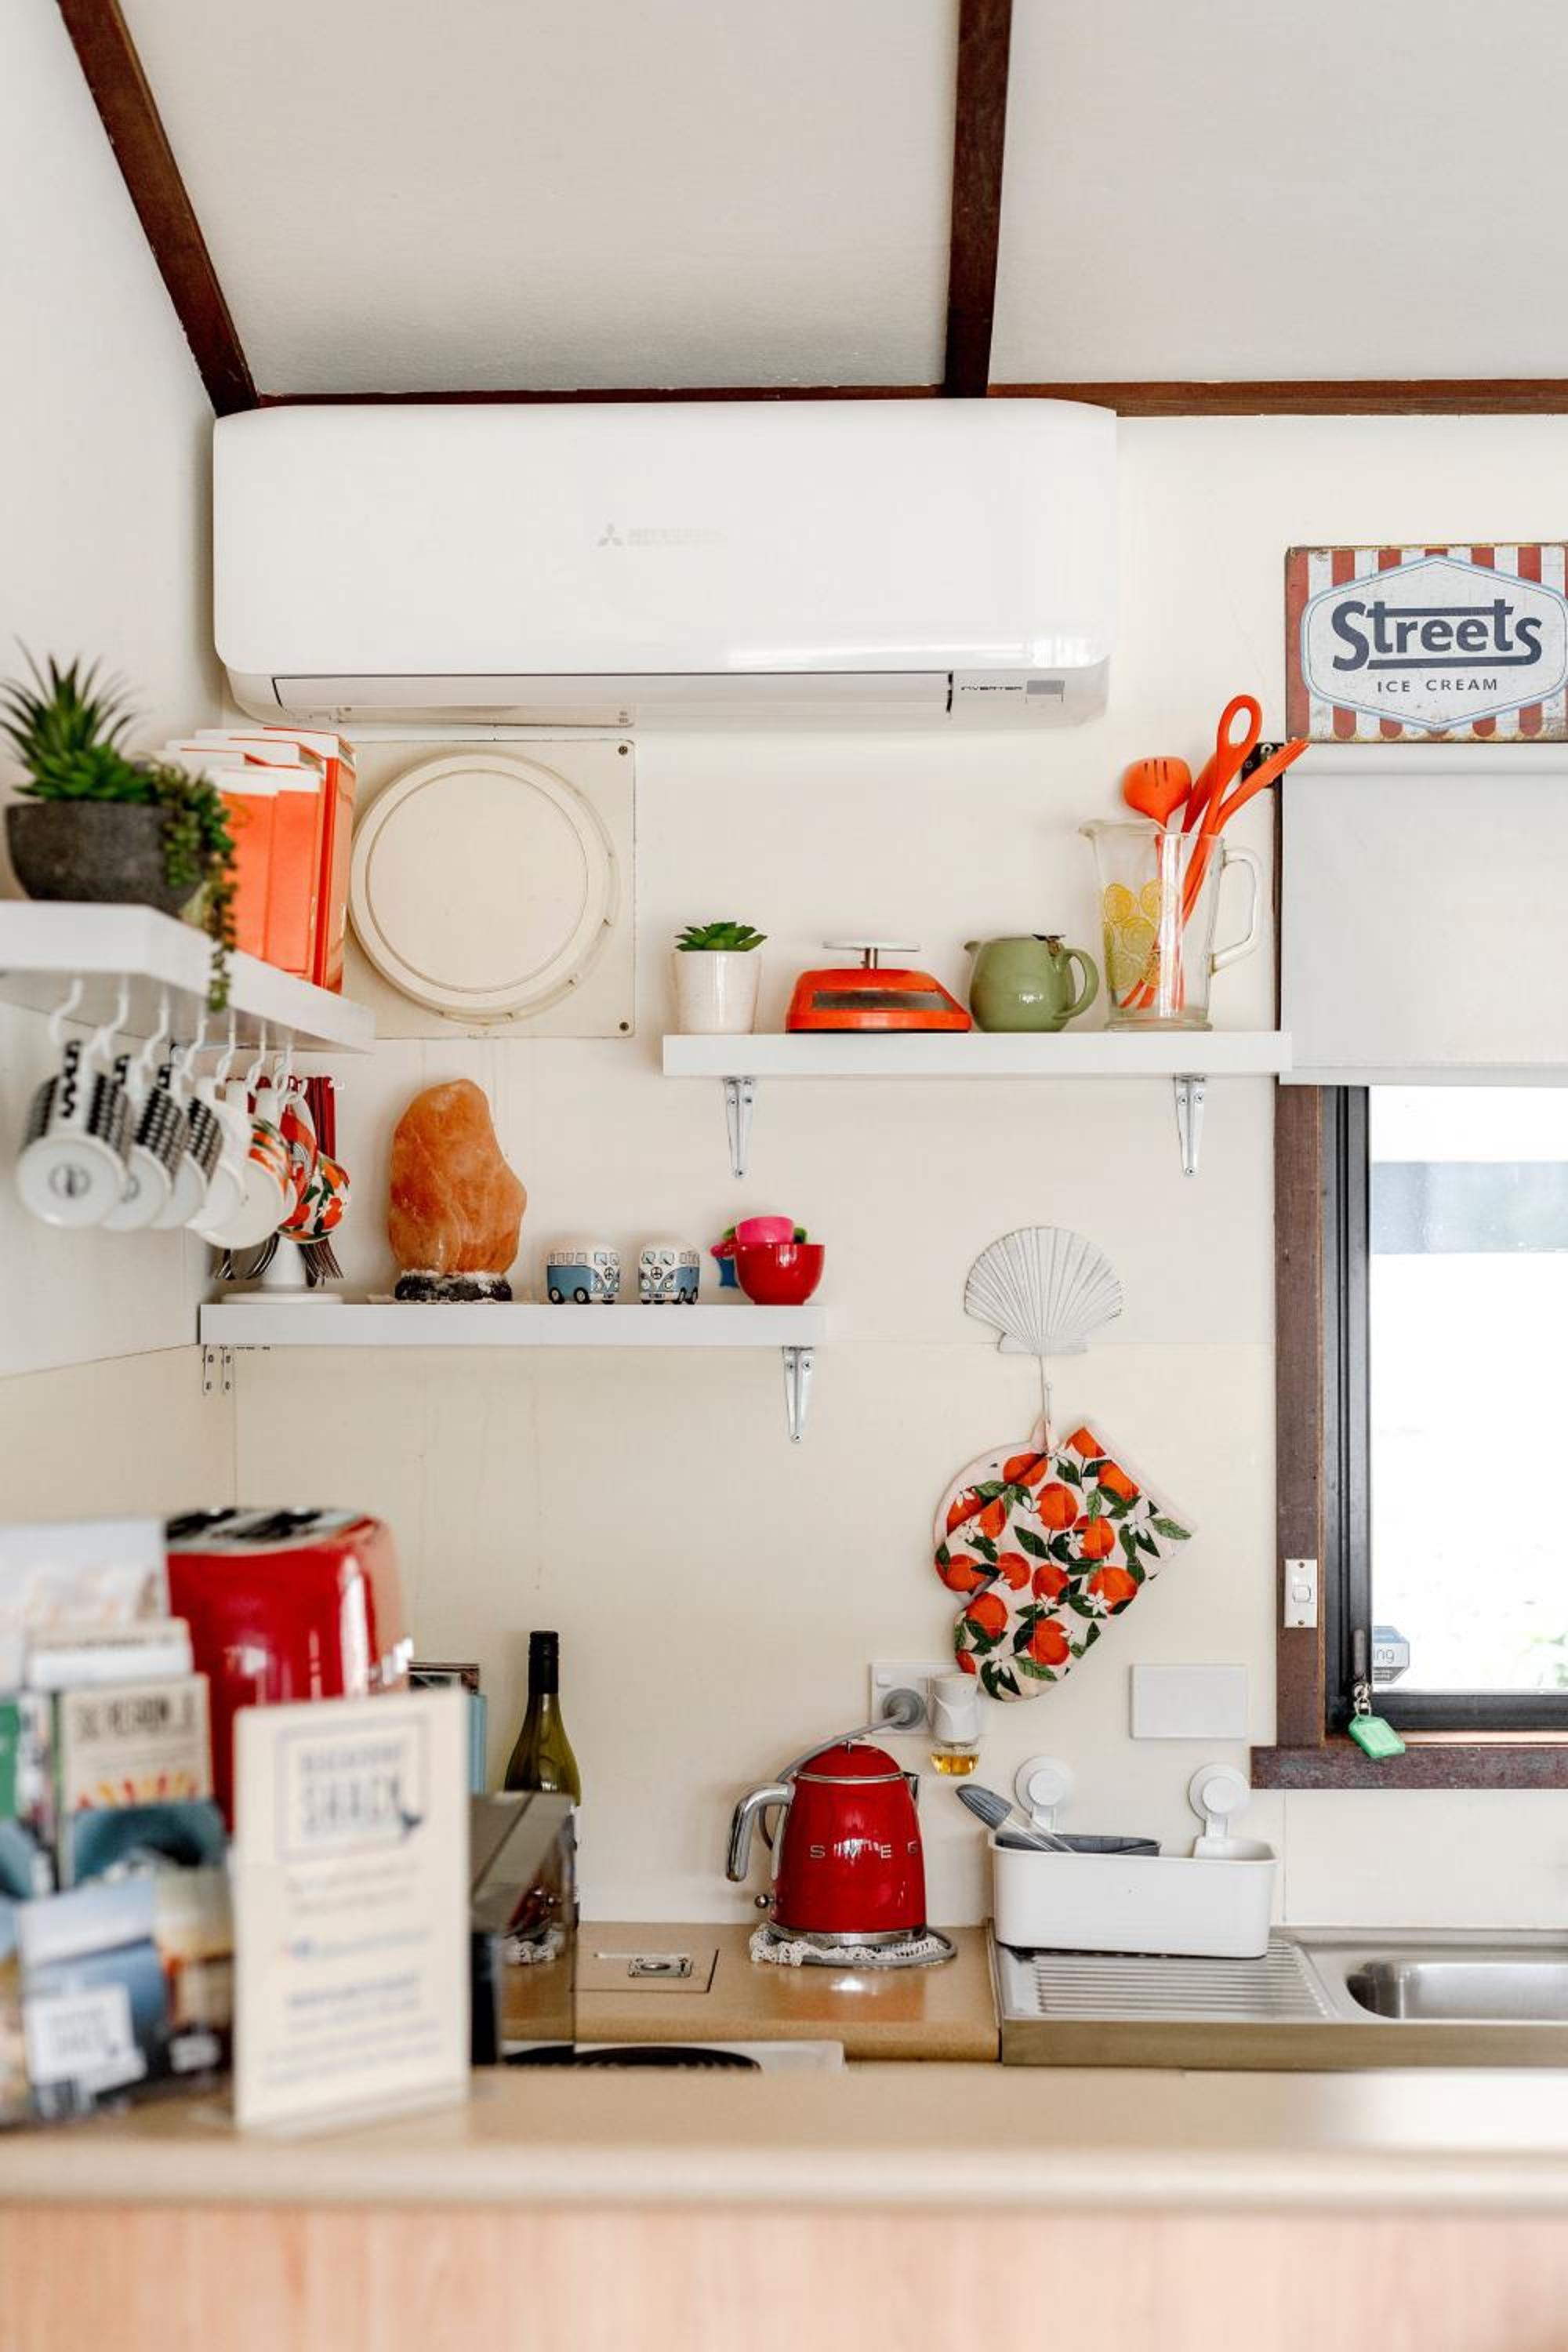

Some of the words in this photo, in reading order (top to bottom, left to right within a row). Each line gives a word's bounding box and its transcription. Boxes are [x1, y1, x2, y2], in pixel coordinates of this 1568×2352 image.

[1330, 598, 1543, 672] Streets
[1377, 680, 1411, 693] ICE
[1425, 678, 1498, 691] CREAM
[1374, 1648, 1394, 1664] ing
[809, 1840, 917, 1860] SMEG
